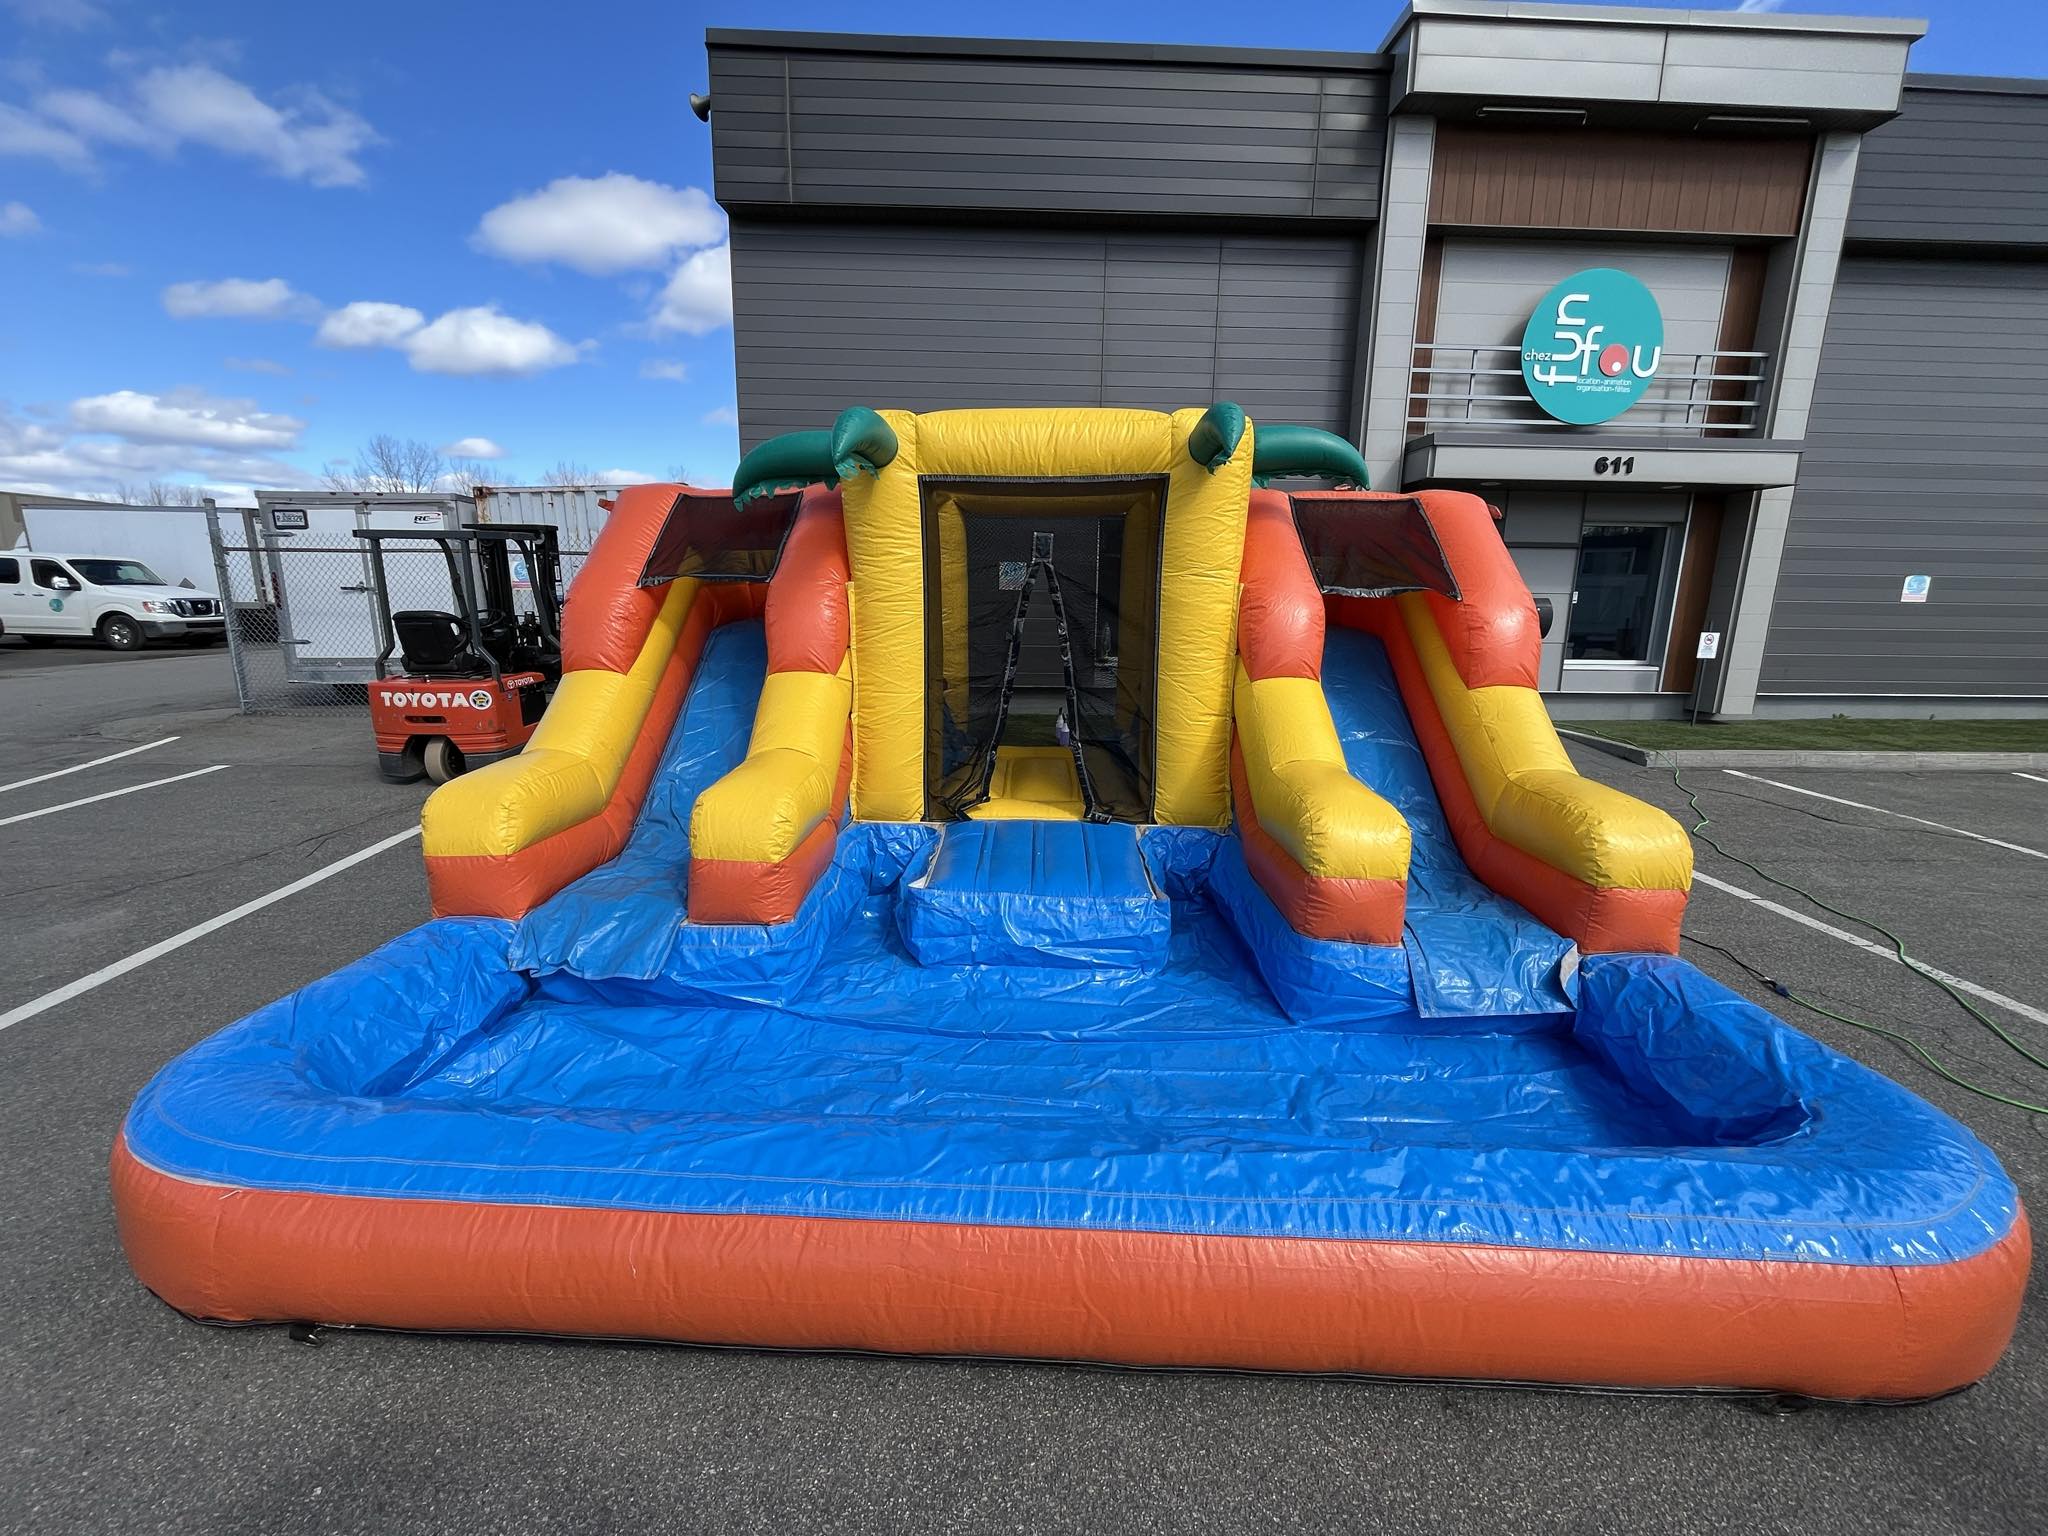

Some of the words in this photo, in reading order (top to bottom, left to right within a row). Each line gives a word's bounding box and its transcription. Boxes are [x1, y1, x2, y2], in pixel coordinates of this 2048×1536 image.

[1524, 349, 1551, 362] chez
[1594, 456, 1635, 474] 611
[514, 676, 535, 687] TOYOTA
[380, 691, 470, 709] TOYOTA
